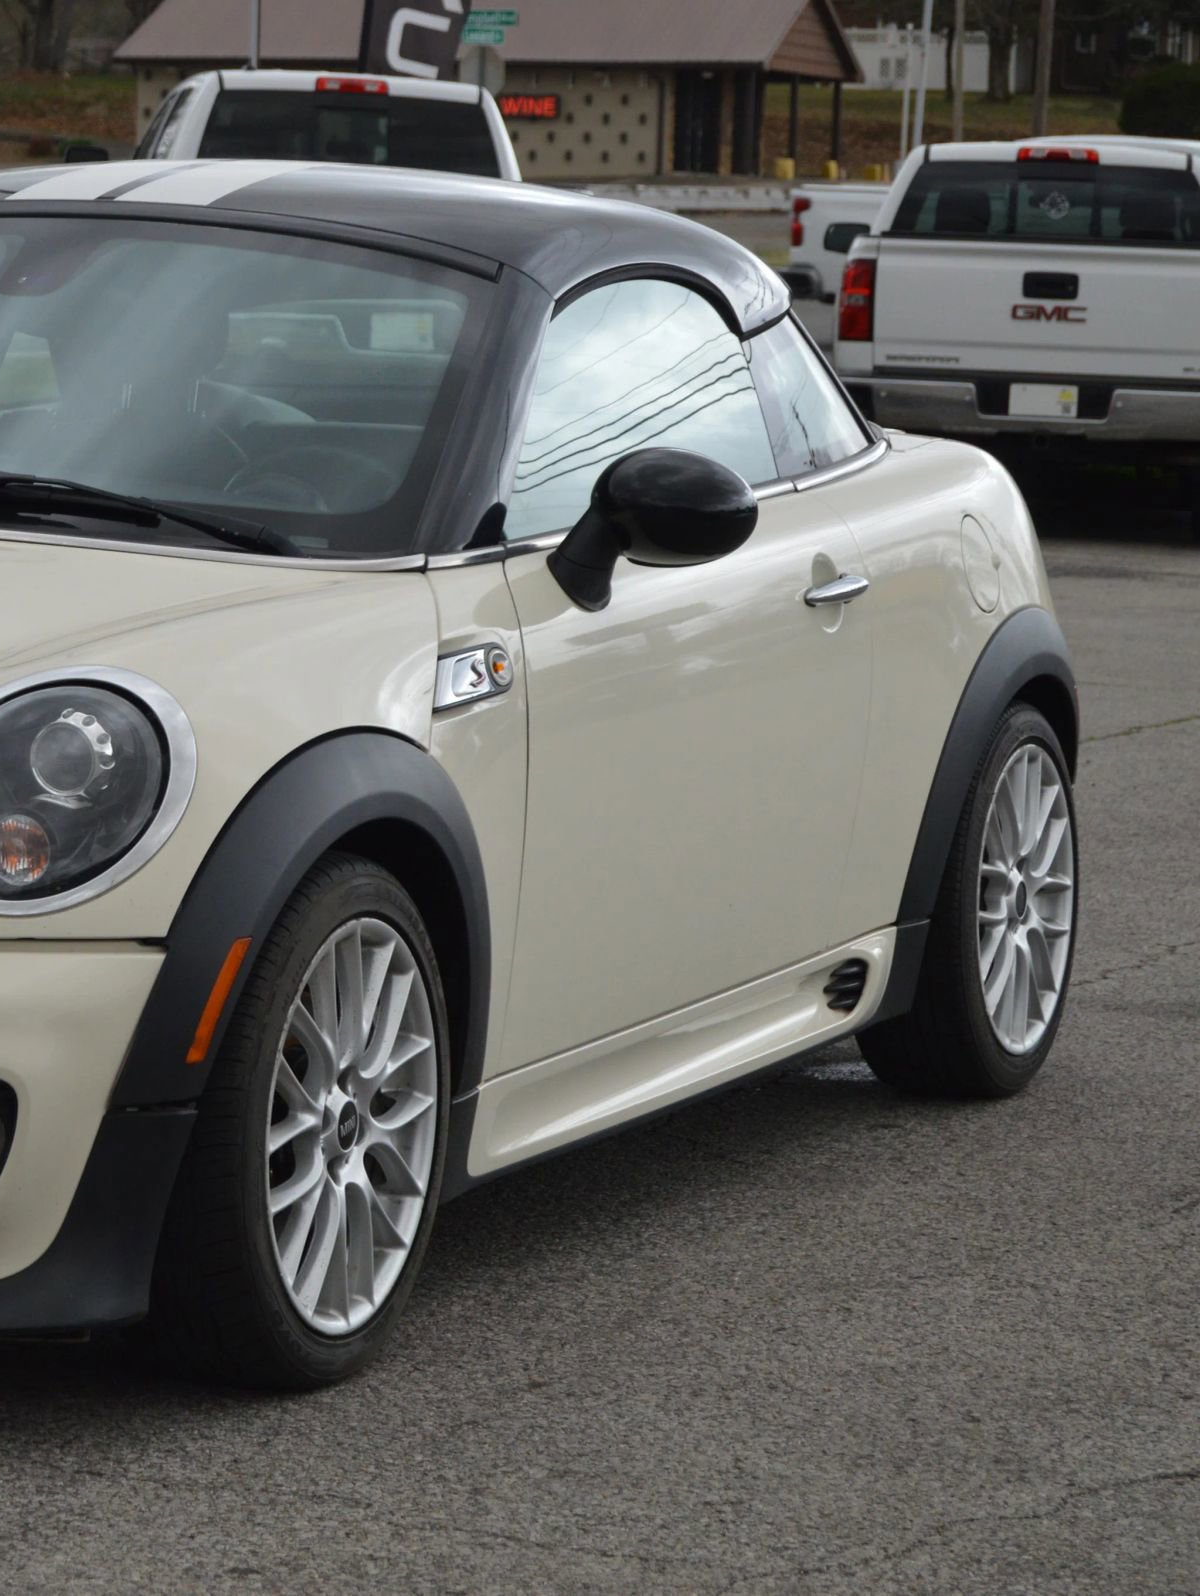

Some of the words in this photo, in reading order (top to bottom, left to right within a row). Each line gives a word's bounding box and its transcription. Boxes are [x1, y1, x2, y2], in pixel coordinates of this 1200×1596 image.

[501, 95, 557, 117] WINE
[1011, 303, 1088, 323] GMC
[340, 1114, 356, 1138] MINI
